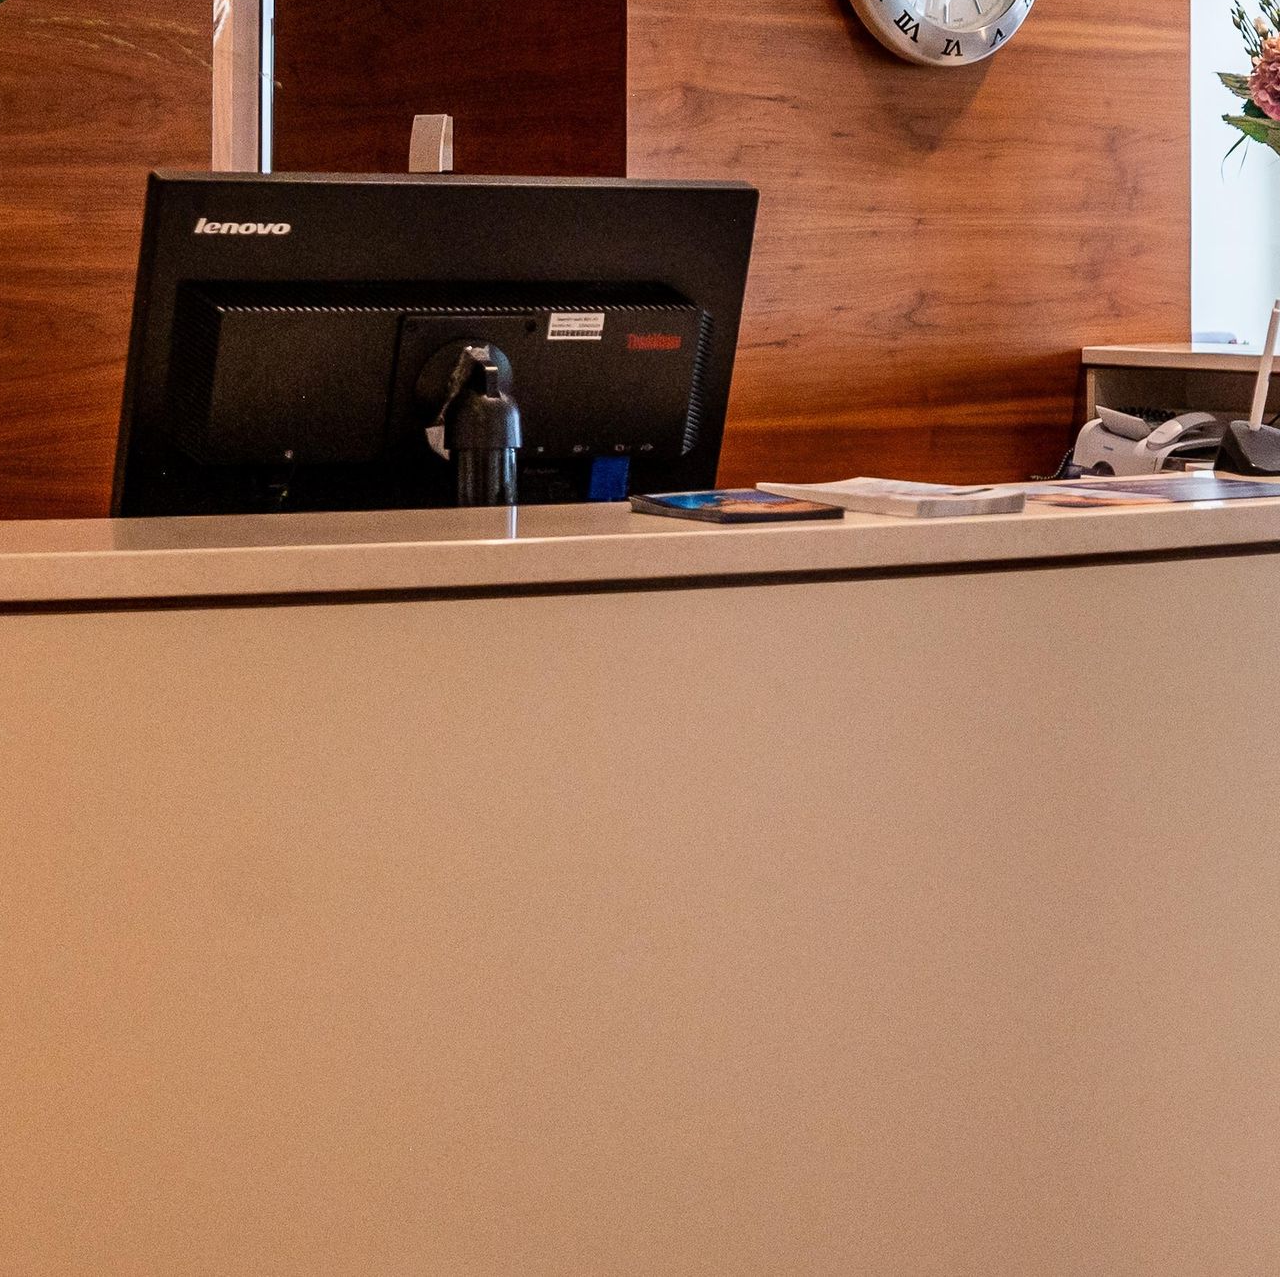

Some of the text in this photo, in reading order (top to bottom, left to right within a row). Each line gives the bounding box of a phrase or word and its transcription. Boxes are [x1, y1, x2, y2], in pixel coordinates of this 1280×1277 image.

[894, 9, 920, 43] VII
[940, 38, 963, 57] VI
[194, 217, 292, 235] lenovo
